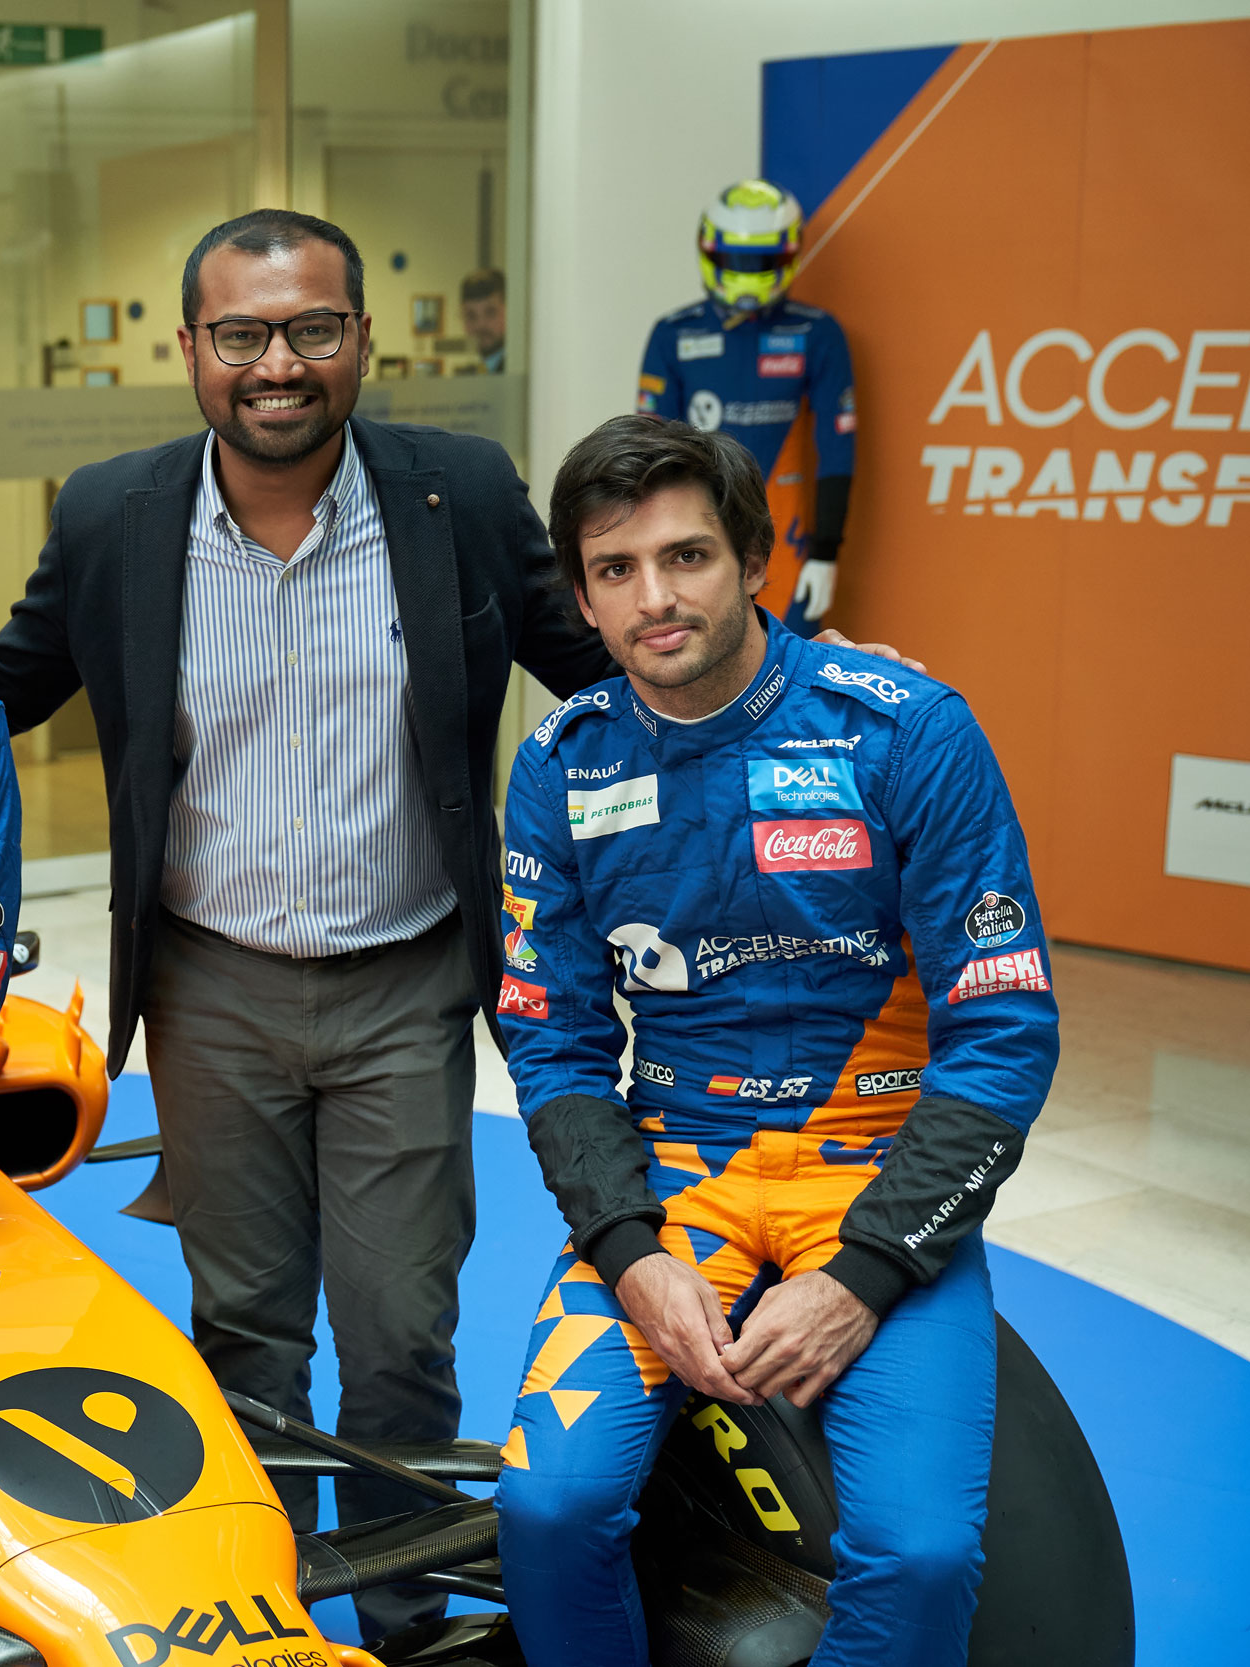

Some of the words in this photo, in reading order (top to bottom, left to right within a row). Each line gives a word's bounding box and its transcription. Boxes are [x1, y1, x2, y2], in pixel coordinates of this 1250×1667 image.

[750, 675, 784, 714] Hilton
[818, 663, 910, 703] sparco
[777, 739, 855, 750] McLaren
[565, 760, 624, 780] ENAULT
[774, 766, 837, 787] DELL
[590, 796, 653, 819] PETROBRAS
[774, 790, 839, 802] Technologies
[764, 827, 859, 861] Coca-Cola
[958, 950, 1043, 989] HUSKI
[958, 976, 1047, 999] CHOCOLATE
[738, 1077, 813, 1102] CS_55
[965, 1141, 1006, 1192] MILLE
[106, 1595, 309, 1667] DELL
